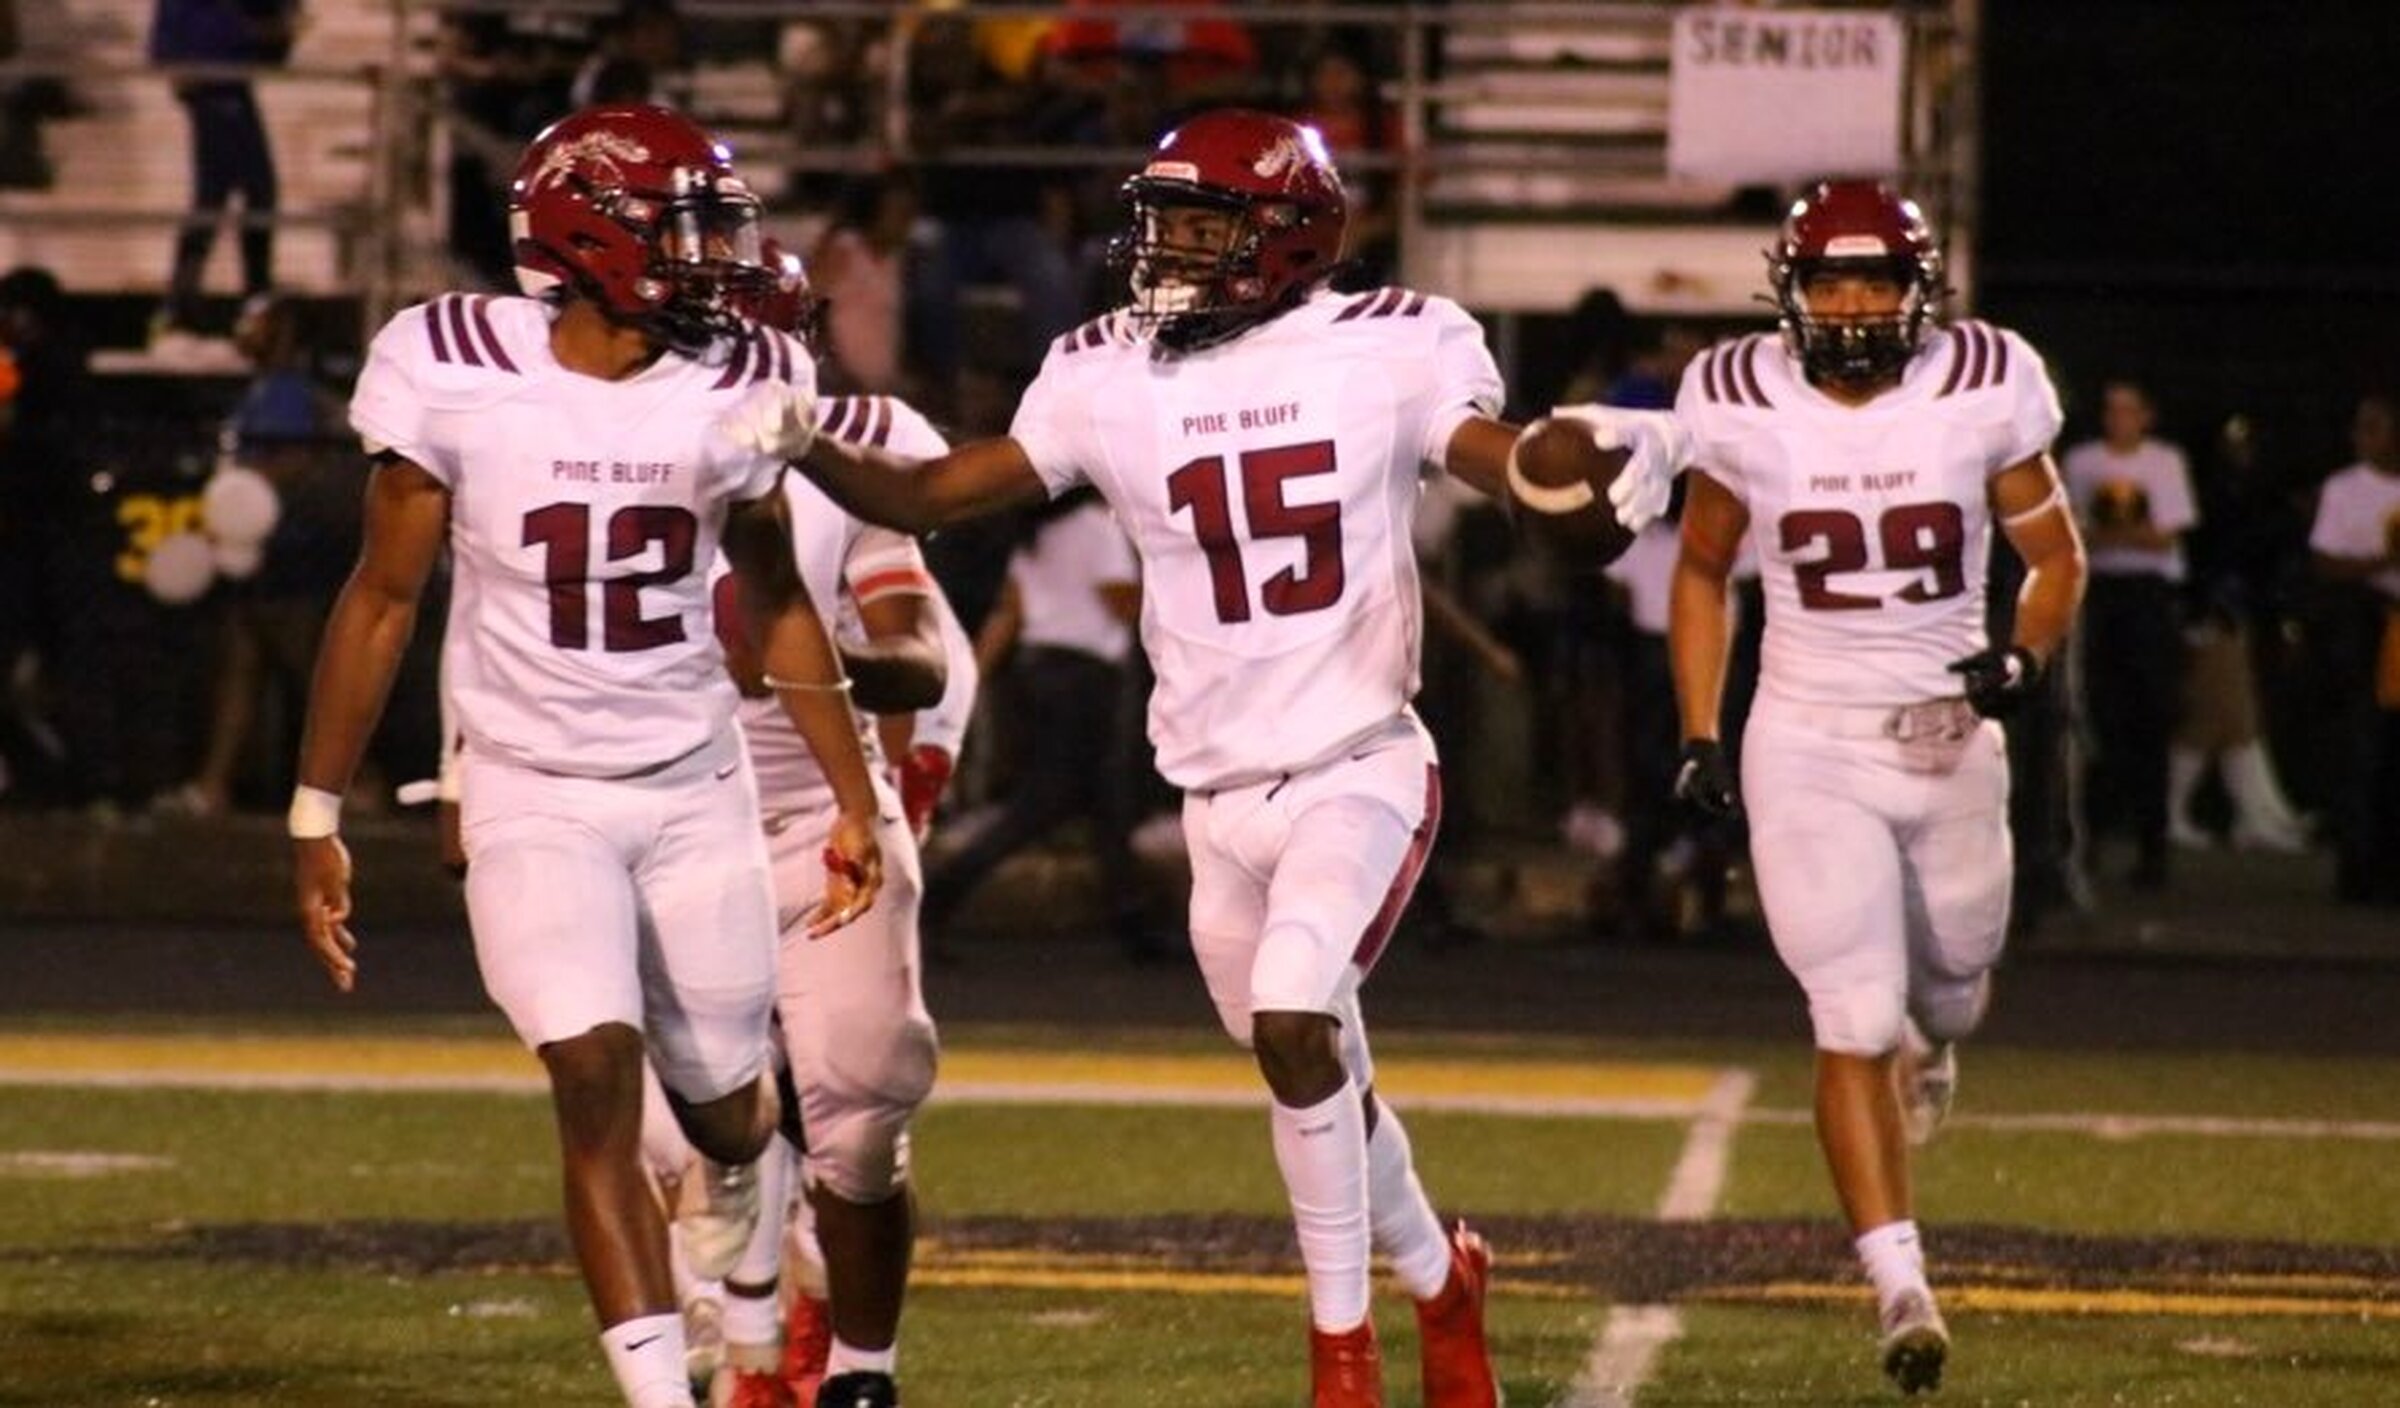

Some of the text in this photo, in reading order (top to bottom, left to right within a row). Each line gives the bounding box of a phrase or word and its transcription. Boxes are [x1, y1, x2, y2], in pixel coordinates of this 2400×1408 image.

[1690, 17, 1876, 69] SENIOR
[1182, 402, 1301, 437] PINE BLUFF
[553, 460, 675, 484] PINE BLUFF
[1810, 470, 1917, 493] PINE BLUFF
[1166, 438, 1346, 626] 15
[1778, 501, 1967, 612] 29
[521, 501, 699, 653] 12
